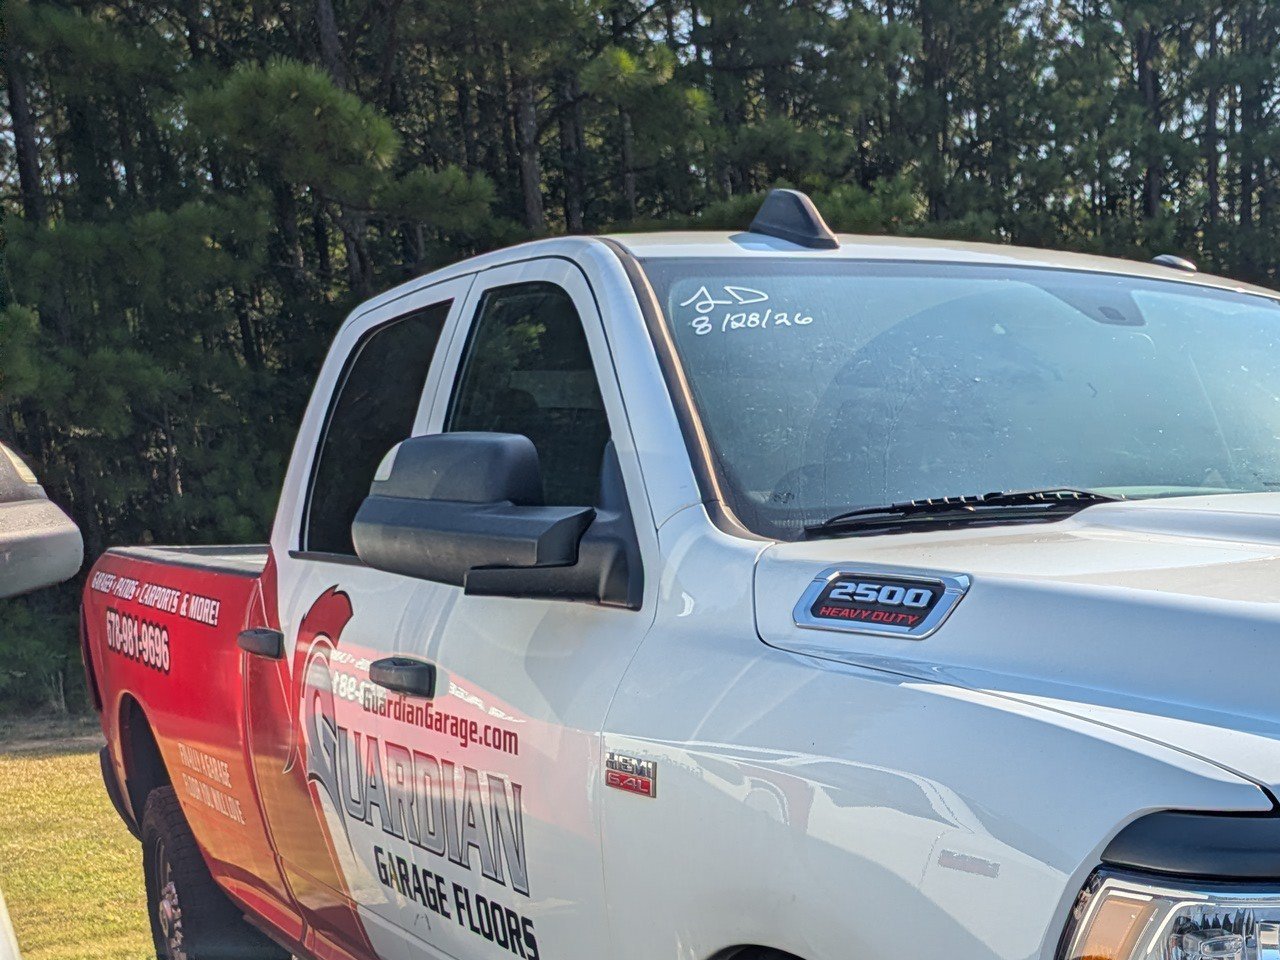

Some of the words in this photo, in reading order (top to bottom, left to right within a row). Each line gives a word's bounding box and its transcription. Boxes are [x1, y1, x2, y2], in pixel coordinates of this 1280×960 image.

[138, 583, 181, 614] CARPORTS
[179, 592, 190, 617] &
[188, 595, 220, 626] MORE!
[819, 606, 873, 620] HEAVY
[872, 611, 919, 625] DUTY
[829, 581, 933, 608] 2500
[106, 607, 171, 675] 678-981-9696
[363, 684, 519, 756] GuardianGarage.com
[302, 680, 530, 898] GUARDIAN
[373, 845, 452, 920] GARAGE
